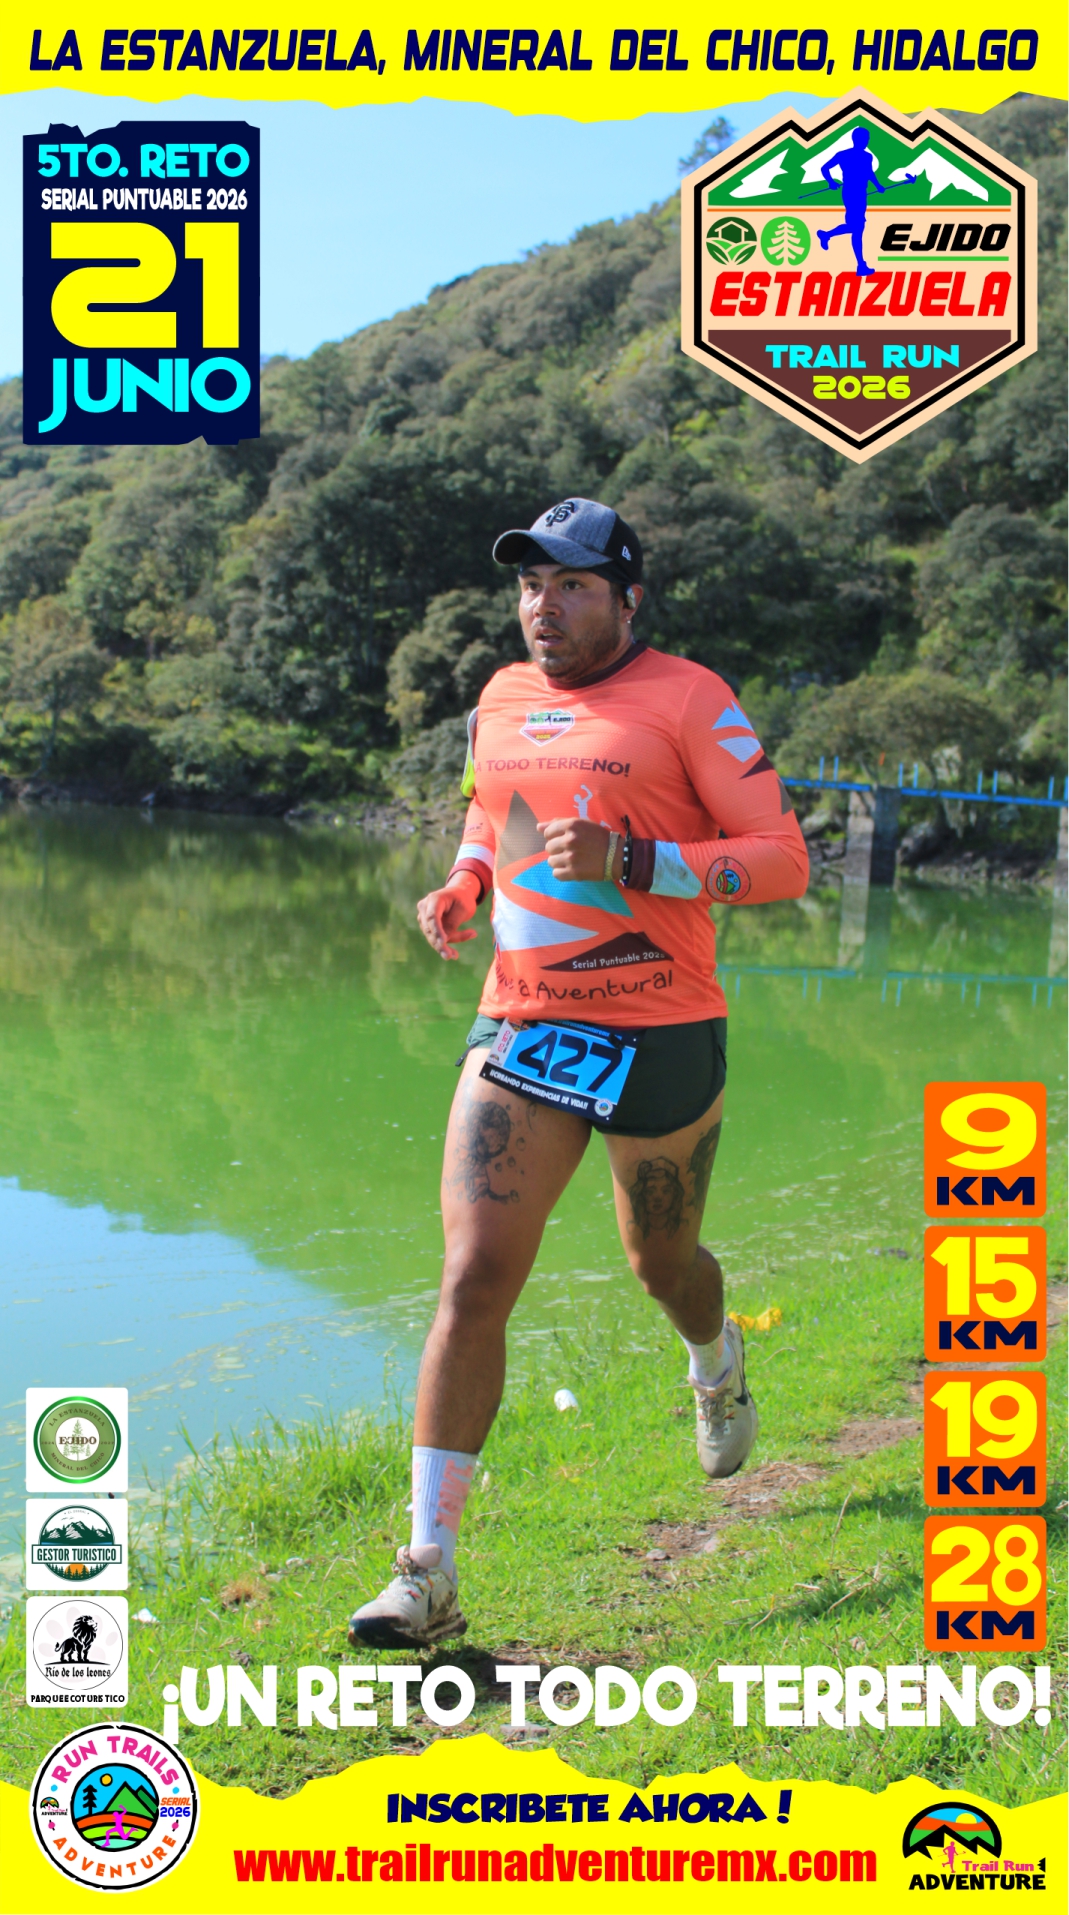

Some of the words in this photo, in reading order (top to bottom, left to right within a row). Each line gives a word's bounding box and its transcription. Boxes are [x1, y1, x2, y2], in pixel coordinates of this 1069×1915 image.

[486, 758, 530, 772] TODO
[536, 757, 631, 778] TERRENO!
[572, 960, 597, 970] Serial
[599, 953, 640, 968] Puntuable
[516, 1030, 623, 1093] 427
[521, 1082, 561, 1103] EXPERIENCIAS
[561, 1095, 570, 1105] DE
